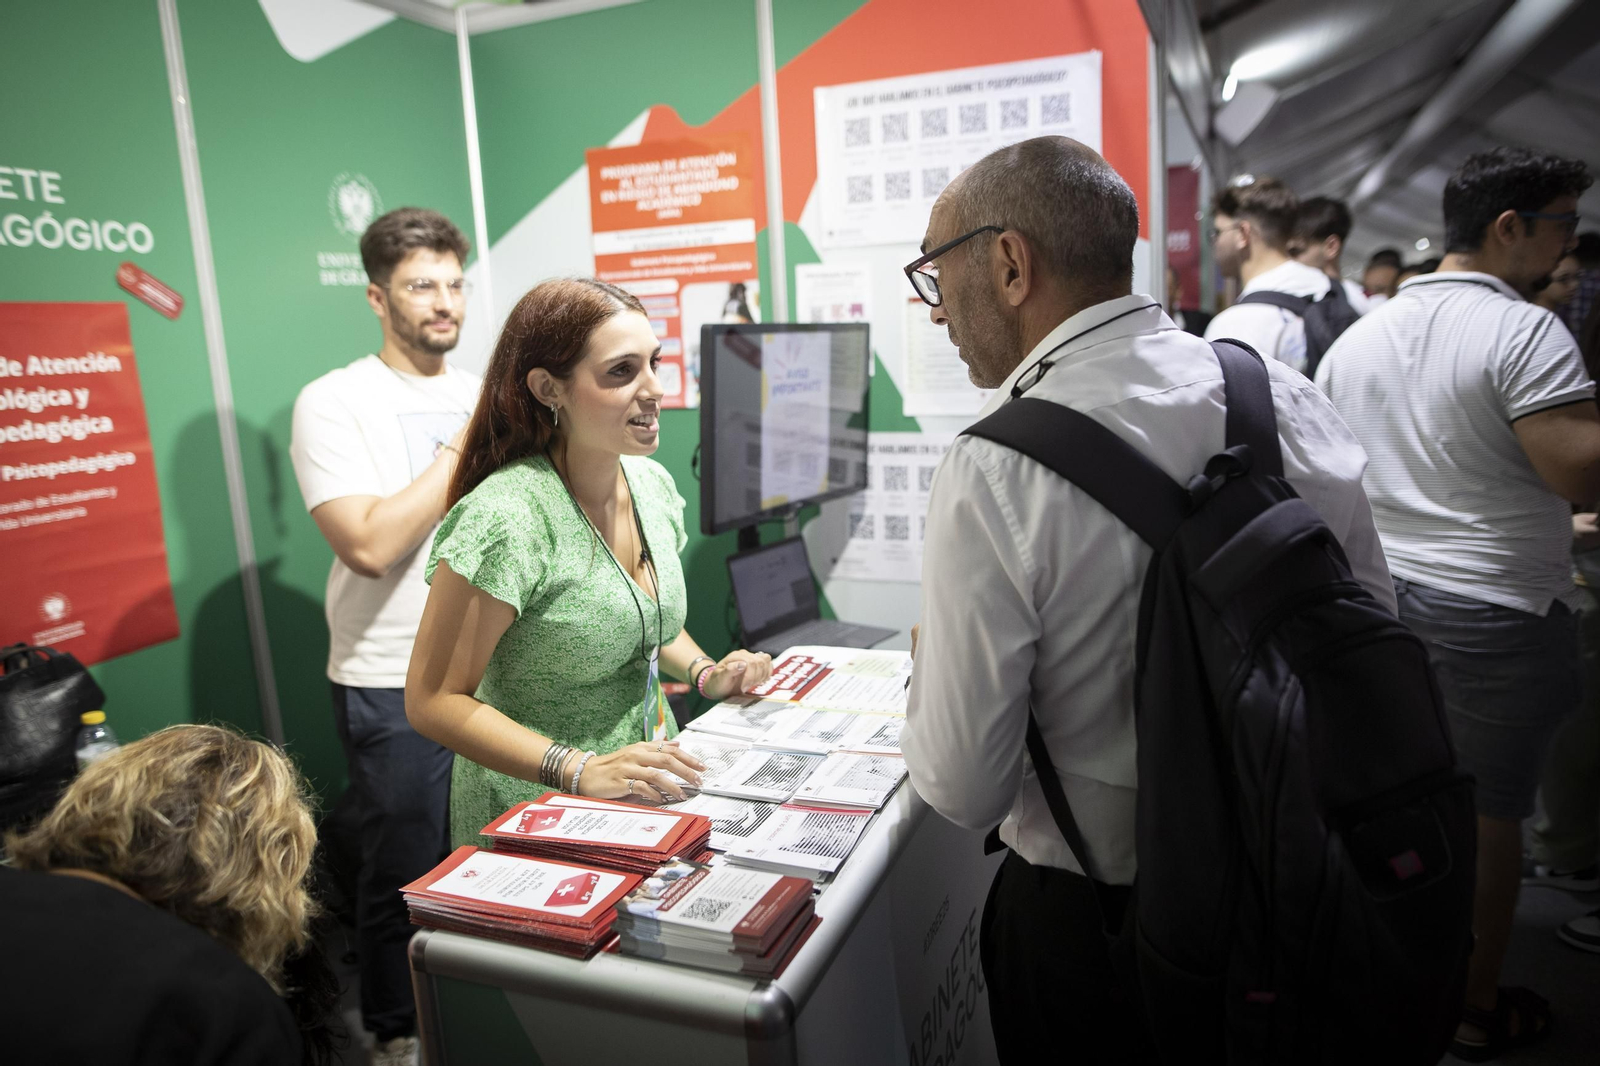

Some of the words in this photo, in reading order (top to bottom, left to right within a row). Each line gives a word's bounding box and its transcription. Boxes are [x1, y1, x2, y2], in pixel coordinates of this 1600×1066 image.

[601, 162, 660, 179] PROGRAMA
[661, 159, 676, 171] DE
[679, 152, 736, 169] ATENCIÓN
[26, 351, 122, 376] Atención
[73, 387, 90, 409] y
[1, 451, 136, 481] Psicopedagógico
